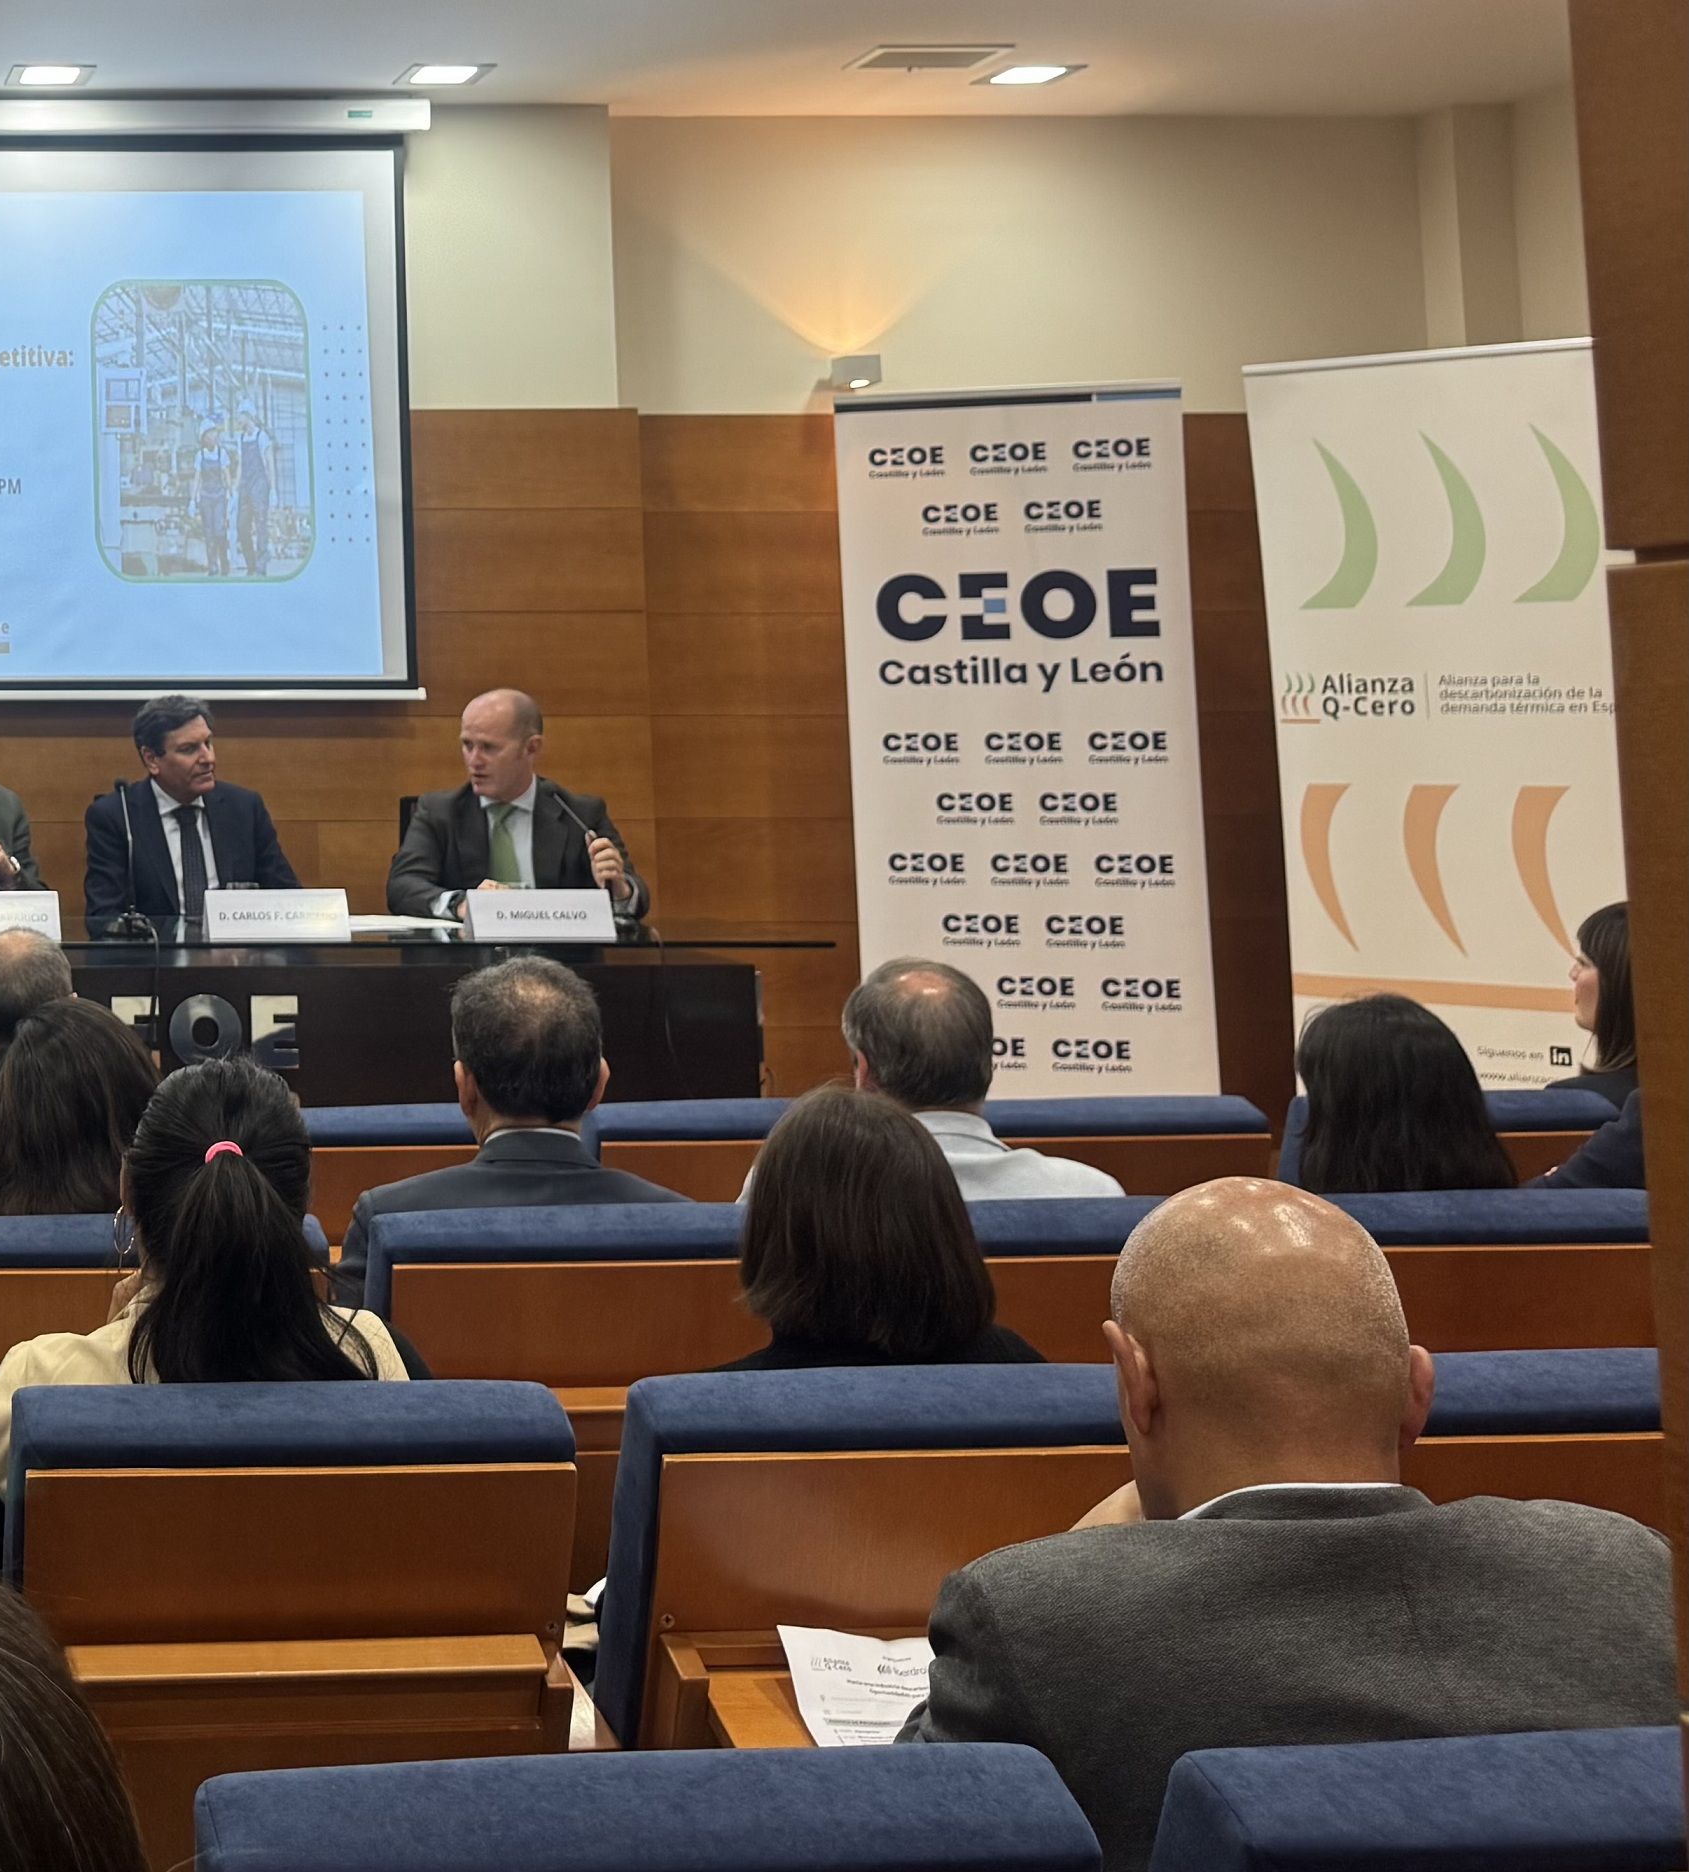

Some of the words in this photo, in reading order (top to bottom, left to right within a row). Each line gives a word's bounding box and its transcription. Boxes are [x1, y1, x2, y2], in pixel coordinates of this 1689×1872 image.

[869, 446, 944, 466] CEOE
[970, 442, 1046, 462] CEOE
[1073, 438, 1150, 459] CEOE
[922, 503, 998, 523] CEOE
[1024, 500, 1101, 520] CEOE
[876, 568, 1160, 641] CEOE
[879, 657, 1027, 686] Castilla
[1038, 663, 1060, 692] y
[1072, 653, 1163, 682] León
[1439, 674, 1486, 685] Alianza
[1492, 676, 1524, 688] para
[1528, 673, 1539, 684] la
[1322, 674, 1414, 694] Alianza
[1439, 687, 1562, 701] descarbonización
[1566, 688, 1584, 698] de
[1590, 687, 1602, 698] la
[1322, 696, 1415, 720] Q-Cero
[1441, 702, 1505, 714] demanda
[1510, 701, 1564, 714] térmica
[1570, 704, 1587, 713] en
[883, 733, 958, 751] CEOE
[985, 733, 1061, 751] CEOE
[1089, 731, 1166, 751] CEOE
[937, 793, 1012, 812] CEOE
[1040, 793, 1116, 812] CEOE
[889, 854, 964, 872] CEOE
[991, 854, 1067, 873] CEOE
[1095, 855, 1173, 874] CEOE
[219, 912, 229, 920] D.
[233, 912, 271, 920] CARLOS
[274, 912, 283, 920] F.
[496, 911, 507, 919] D.
[510, 911, 550, 919] MIGUEL
[553, 911, 586, 919] CALVO
[943, 915, 1019, 934] CEOE
[1046, 916, 1124, 935] CEOE
[997, 977, 1074, 996] CEOE
[1101, 978, 1180, 999] CEOE
[111, 994, 299, 1069] EOE
[993, 1038, 1025, 1057] OE
[1052, 1039, 1130, 1060] CEOE
